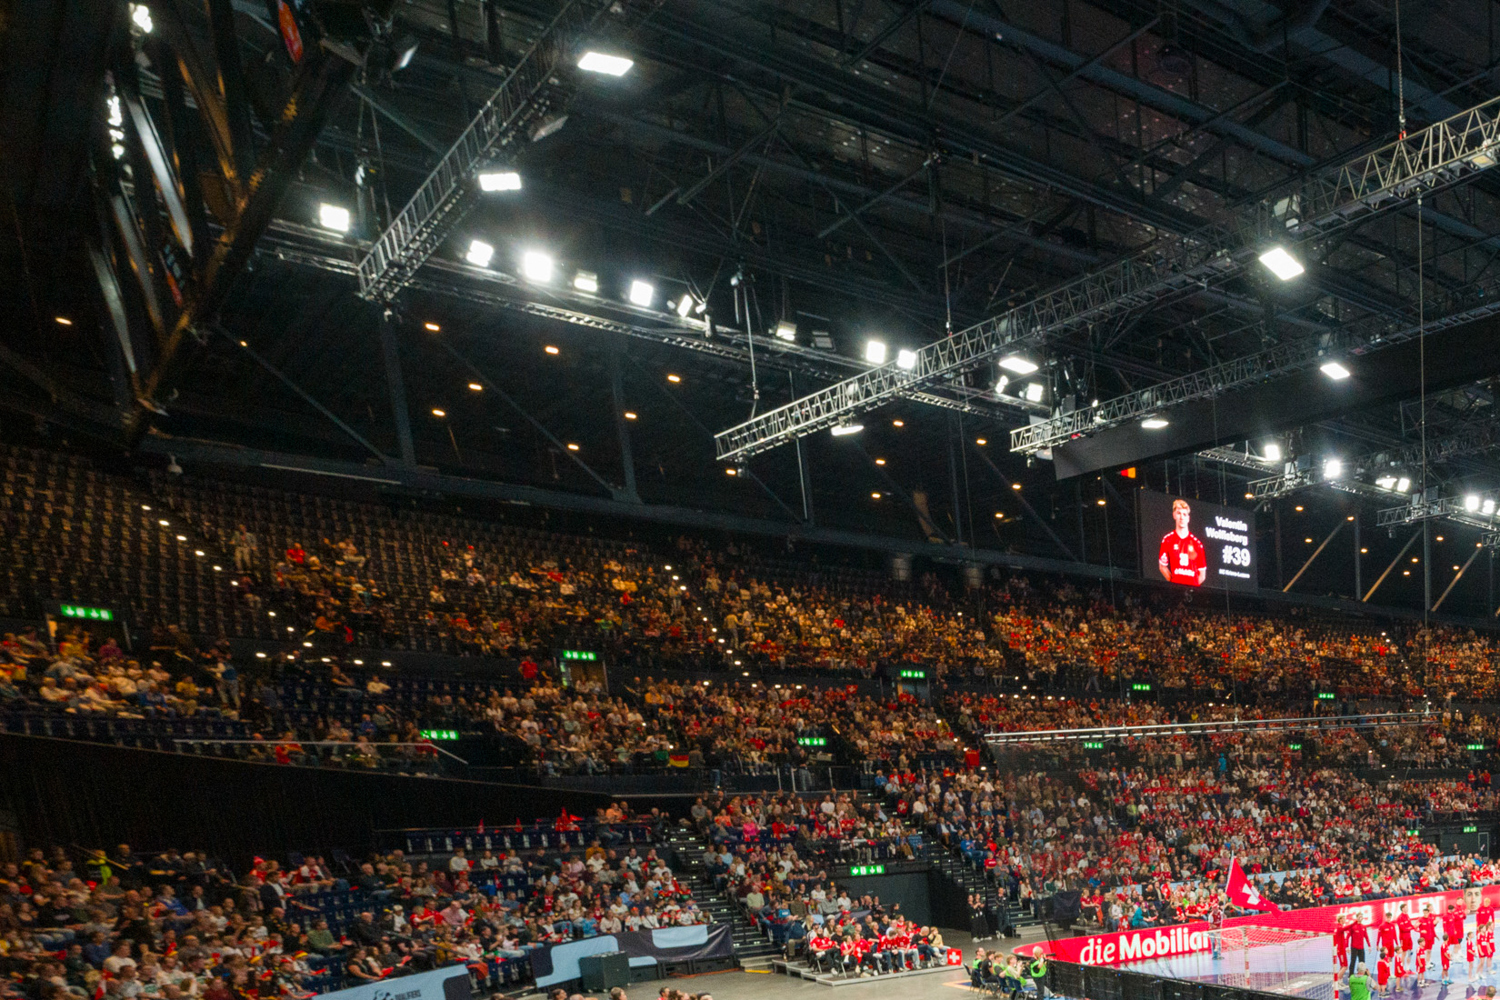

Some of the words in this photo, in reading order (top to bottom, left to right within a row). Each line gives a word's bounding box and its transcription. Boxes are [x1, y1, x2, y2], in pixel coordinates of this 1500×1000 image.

[1222, 545, 1251, 567] #39
[1079, 937, 1116, 966] die
[1118, 927, 1210, 961] Mobiliar
